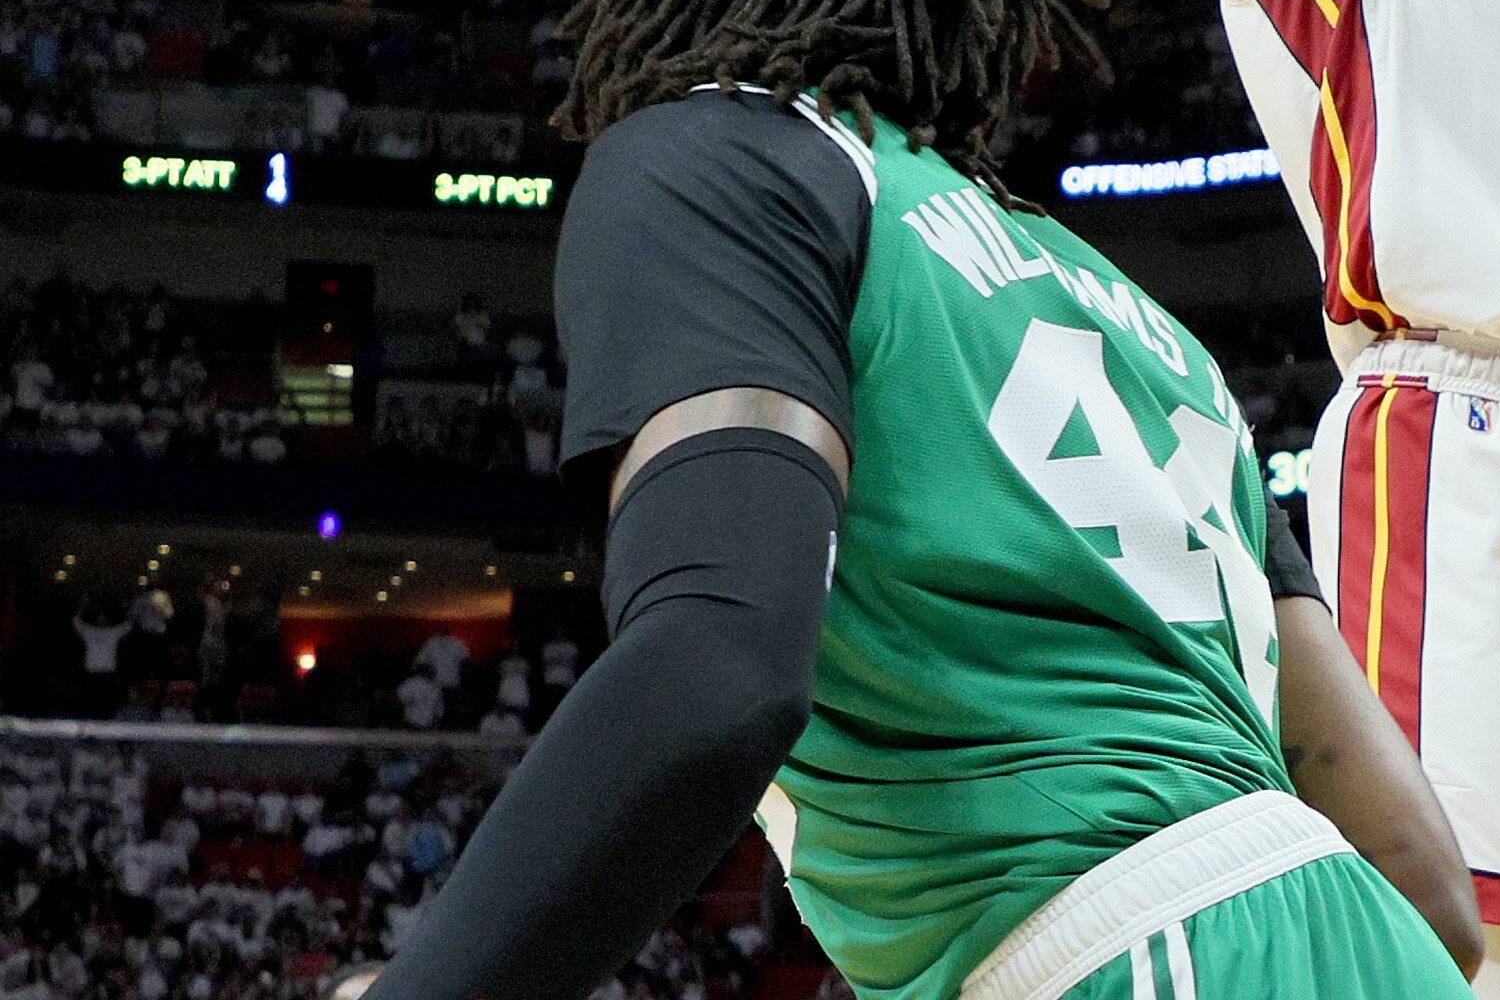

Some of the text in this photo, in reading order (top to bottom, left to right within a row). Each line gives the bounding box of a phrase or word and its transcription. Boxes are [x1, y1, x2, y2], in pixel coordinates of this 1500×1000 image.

[122, 155, 236, 190] 3-PT ATT
[434, 172, 553, 206] 3-PT PCT
[1061, 149, 1281, 195] OFFENSIVE STATS
[901, 187, 1190, 378] WILAMS
[988, 316, 1278, 730] 44
